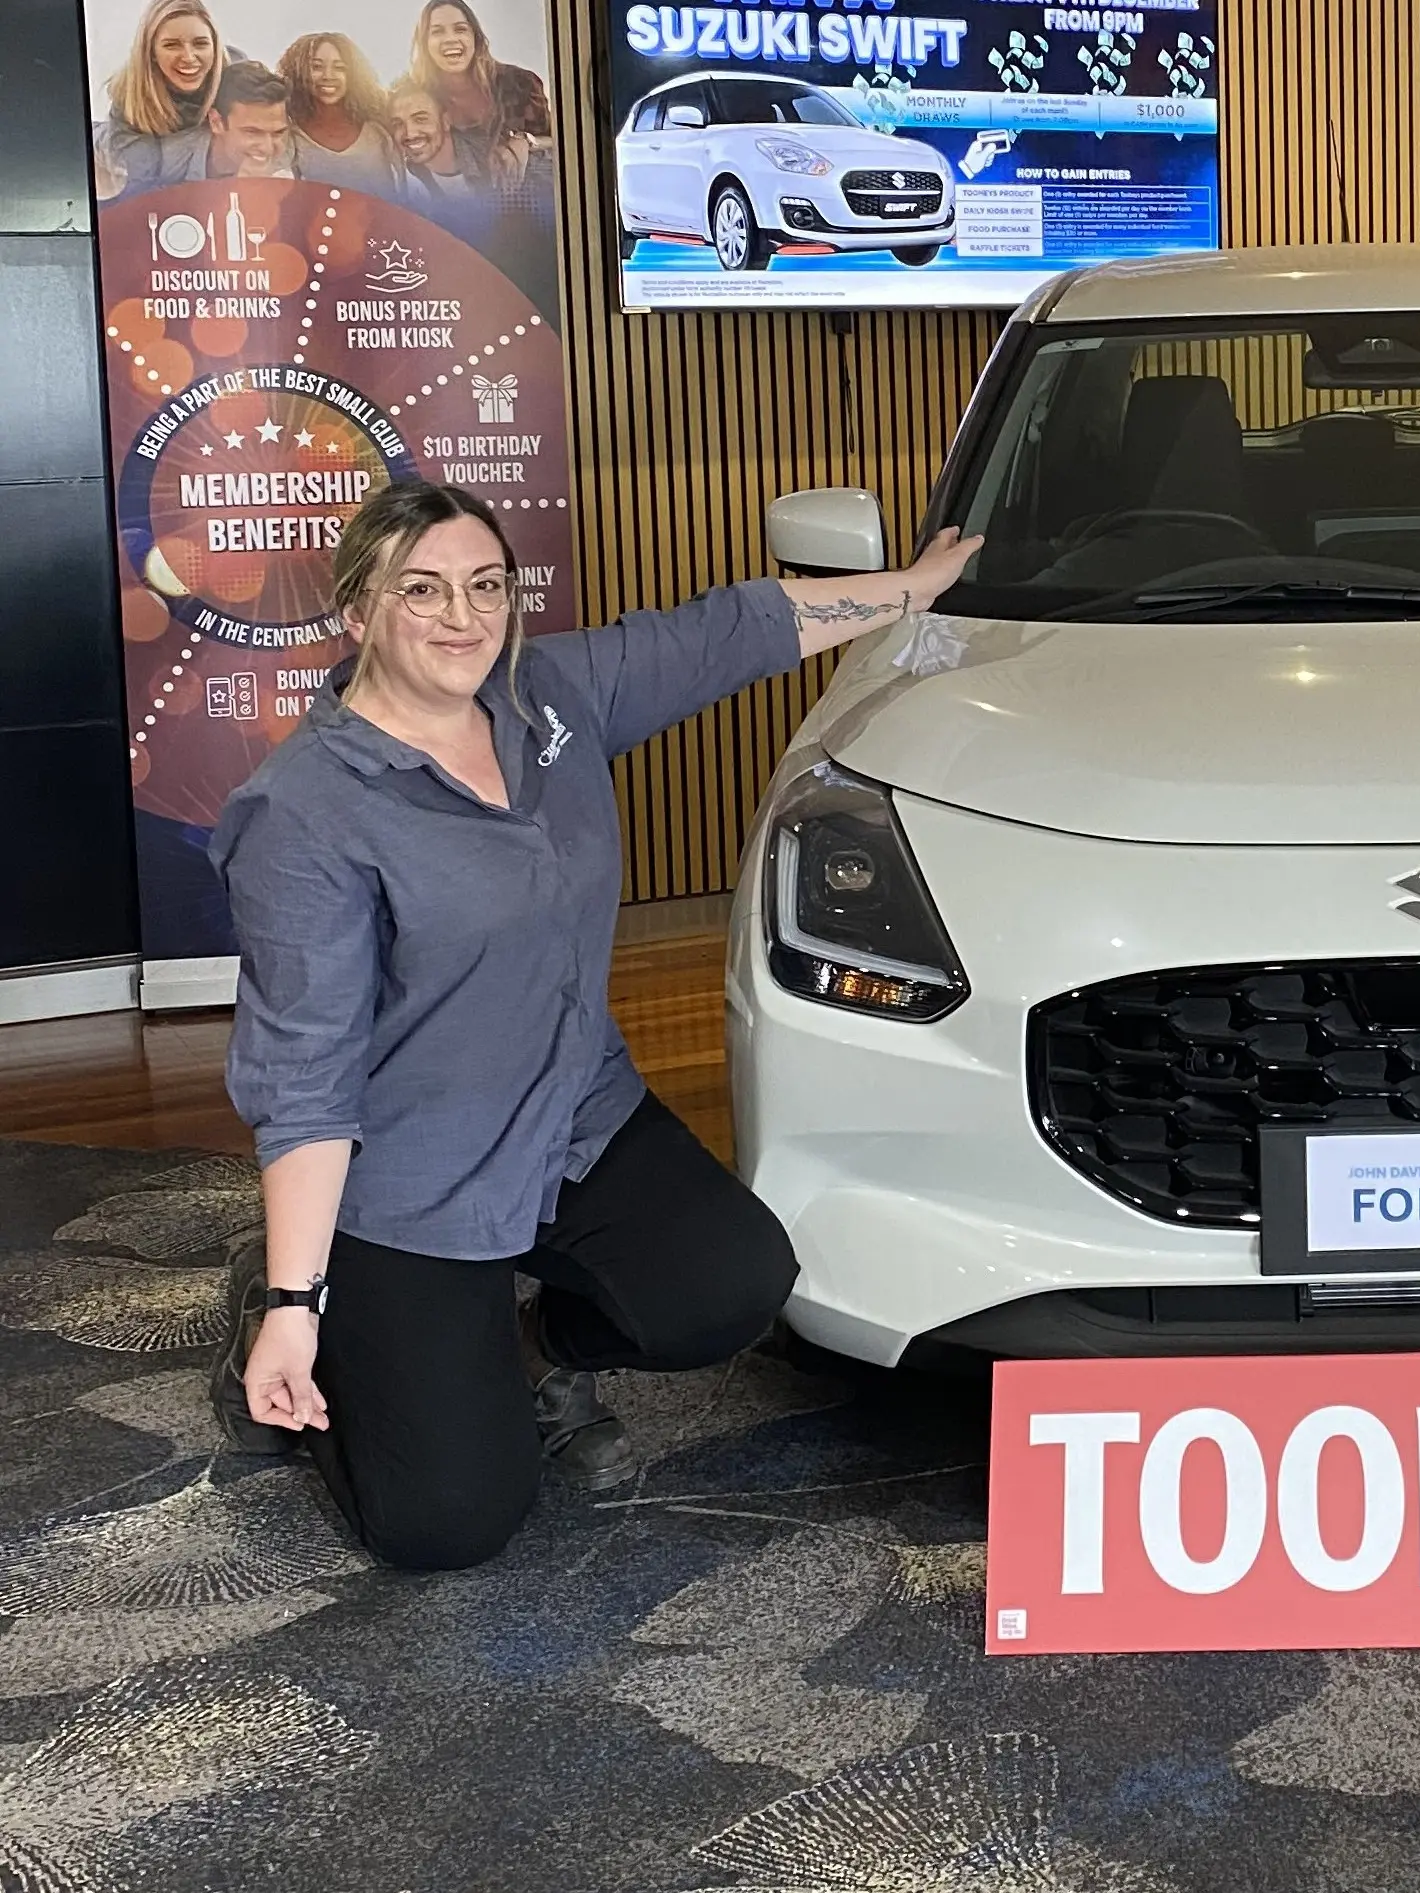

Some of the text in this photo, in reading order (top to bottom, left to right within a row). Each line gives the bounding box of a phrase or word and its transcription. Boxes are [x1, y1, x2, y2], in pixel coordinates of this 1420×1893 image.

[1044, 8, 1100, 31] FROM
[627, 4, 968, 67] SUZUKI SWIFT
[906, 96, 966, 108] MONTHLY
[1137, 104, 1185, 119] $1,000
[913, 112, 960, 122] DRAWS
[1016, 168, 1131, 180] HOW TO GAIN ENTRIES
[151, 269, 271, 292] DISCOUNT ON
[144, 297, 281, 319] FOOD & DRINKS
[336, 300, 461, 323] BONUS PRIZES
[347, 326, 454, 349] FROM KIOSK
[136, 368, 405, 461] BEING A PART OF THE BEST SMALL CLUB
[423, 435, 542, 459] $10 BIRTHDAY
[443, 462, 525, 484] VOUCHER
[179, 471, 371, 507] MEMBERSHIP
[207, 516, 343, 552] BENEFITS
[194, 608, 218, 631] IN
[217, 617, 250, 644] THE
[252, 622, 326, 647] CENTRAL
[276, 668, 330, 690] BONU
[275, 696, 300, 717] ON
[1347, 1166, 1387, 1179] JOHN
